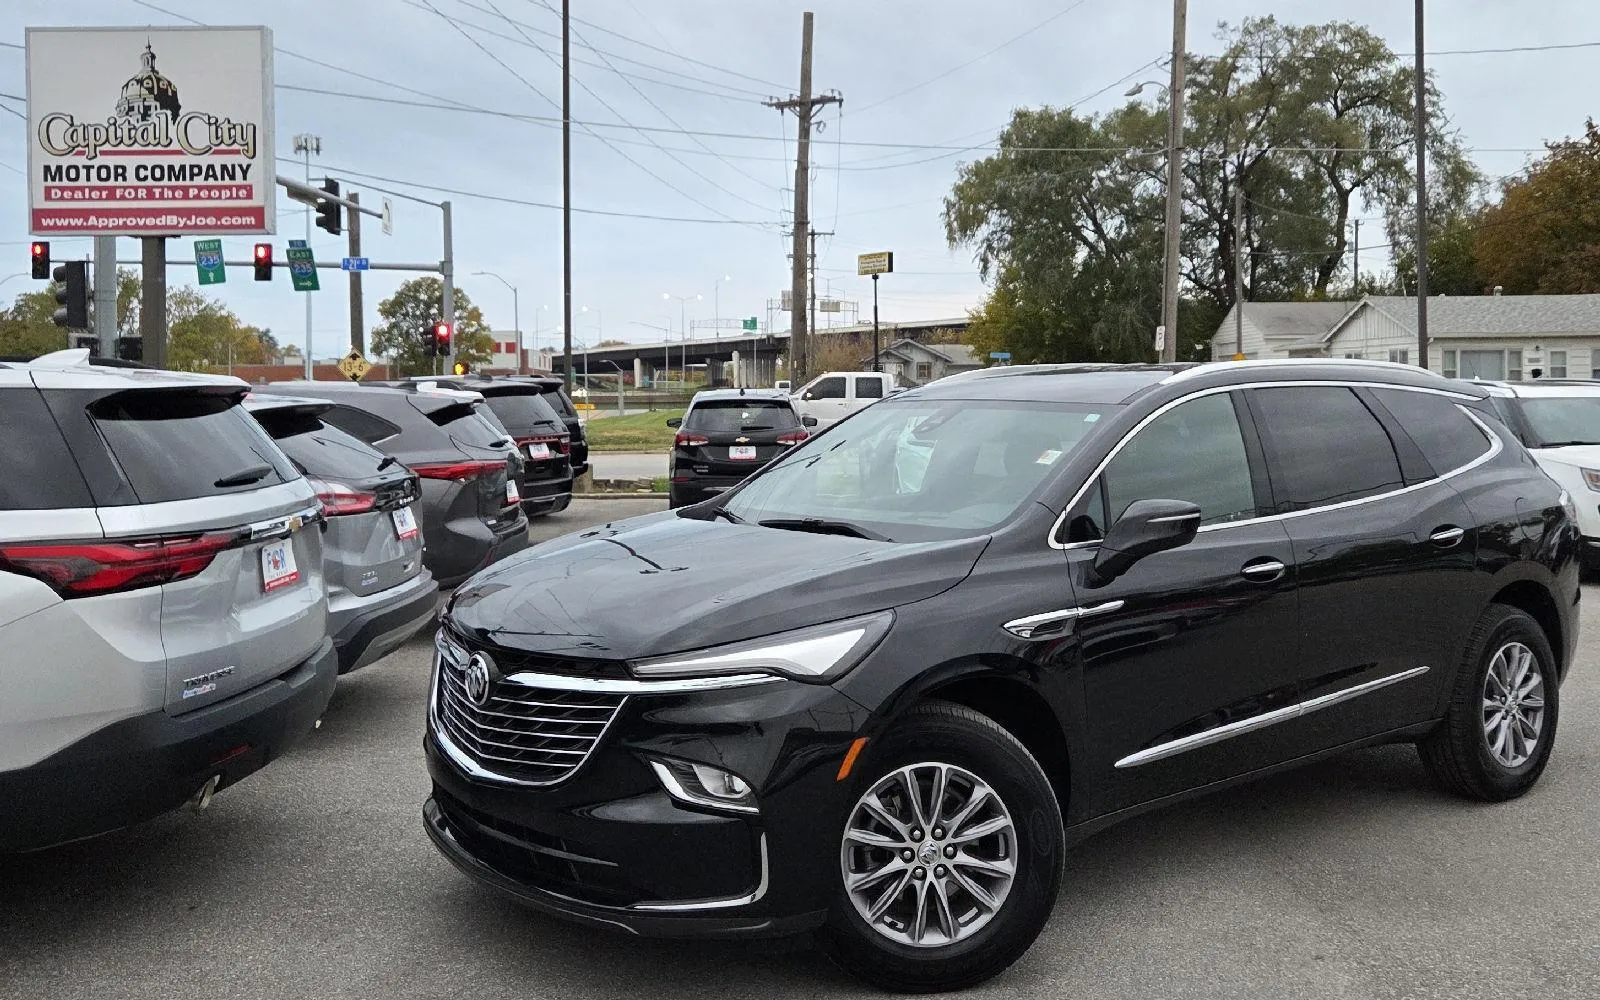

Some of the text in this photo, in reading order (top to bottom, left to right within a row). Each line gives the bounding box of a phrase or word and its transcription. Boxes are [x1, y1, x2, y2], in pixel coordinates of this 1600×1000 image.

[38, 111, 256, 160] Capital City
[43, 163, 252, 182] MOTOR COMPANY
[51, 186, 248, 200] Dealer FOR The People
[41, 215, 256, 228] www.ApprovedByJoe.com
[197, 241, 219, 251] WEST
[201, 255, 220, 265] 235
[290, 250, 310, 260] EAST
